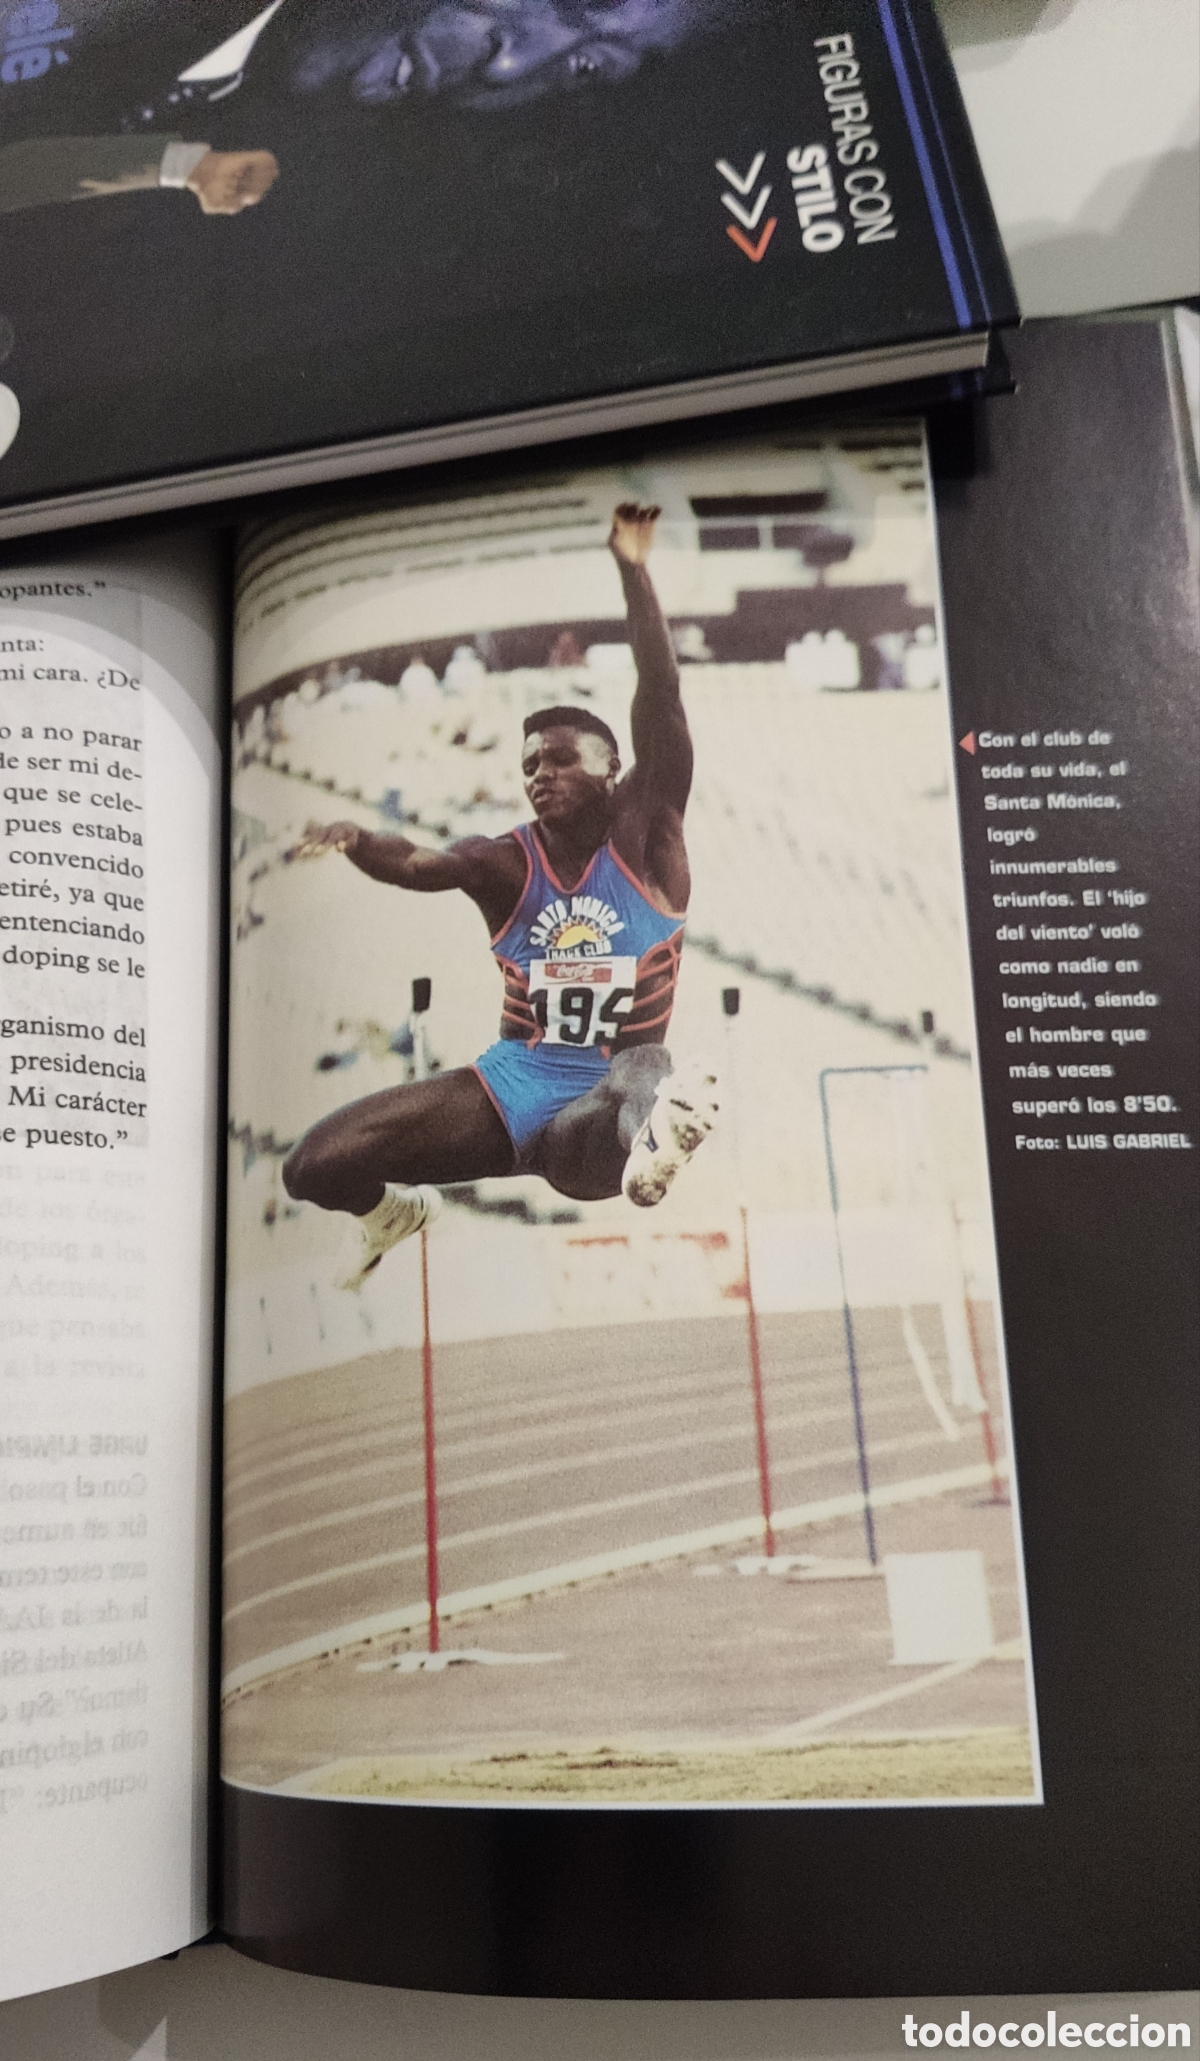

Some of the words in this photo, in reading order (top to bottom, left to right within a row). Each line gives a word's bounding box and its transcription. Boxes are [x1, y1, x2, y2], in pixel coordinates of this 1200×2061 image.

[813, 33, 879, 166] FIGURAS
[787, 143, 845, 252] STILO
[844, 168, 898, 245] CON
[1, 638, 45, 653] nta:
[33, 666, 88, 683] cara.
[97, 669, 140, 691] ¿De
[22, 726, 34, 740] a
[43, 726, 73, 741] no
[83, 729, 142, 751] parar
[979, 732, 1014, 748] Con
[1021, 731, 1036, 747] el
[1044, 731, 1082, 746] club
[1088, 730, 1111, 745] de
[27, 755, 62, 770] ser
[69, 757, 99, 775] mi
[107, 761, 142, 781] de-
[981, 763, 1023, 779] toda
[1031, 764, 1052, 777] su
[1059, 762, 1102, 778] vida,
[1110, 761, 1127, 776] el
[4, 786, 48, 804] que
[58, 789, 81, 803] se
[91, 791, 143, 812] cele-
[984, 794, 1040, 810] Santa
[5, 818, 62, 836] pues
[72, 823, 143, 846] estaba
[987, 827, 1036, 846] logró
[9, 850, 144, 879] convencido
[990, 858, 1117, 874] innumerables
[0, 880, 60, 903] etiré,
[69, 885, 95, 905] ya
[104, 891, 145, 911] que
[993, 892, 1074, 907] triunfos.
[1083, 890, 1101, 906] El
[0, 916, 145, 945] entenciando
[529, 899, 567, 946] SANTA
[571, 896, 625, 936] MONICA
[996, 925, 1024, 940] del
[1101, 923, 1140, 939] voló
[583, 940, 612, 957] CLUB
[3, 946, 90, 973] doping
[97, 957, 120, 973] se
[128, 958, 145, 978] le
[1000, 961, 1050, 974] como
[1058, 958, 1108, 973] nadie
[1115, 960, 1139, 972] en
[1002, 992, 1087, 1012] longitud,
[1095, 991, 1158, 1007] siendo
[114, 1025, 146, 1047] del
[1006, 1027, 1022, 1043] el
[1030, 1026, 1104, 1043] hombre
[1111, 1029, 1147, 1046] que
[10, 1053, 146, 1082] presidencia
[1009, 1062, 1050, 1078] más
[1057, 1064, 1113, 1077] veces
[8, 1086, 46, 1107] Mi
[55, 1091, 147, 1118] carácter
[1012, 1097, 1080, 1117] superó
[1088, 1097, 1116, 1113] los
[26, 1126, 128, 1150] puesto.”
[1016, 1135, 1059, 1150] Foto:
[1067, 1134, 1107, 1149] LUIS
[1113, 1134, 1191, 1149] GABRIEL
